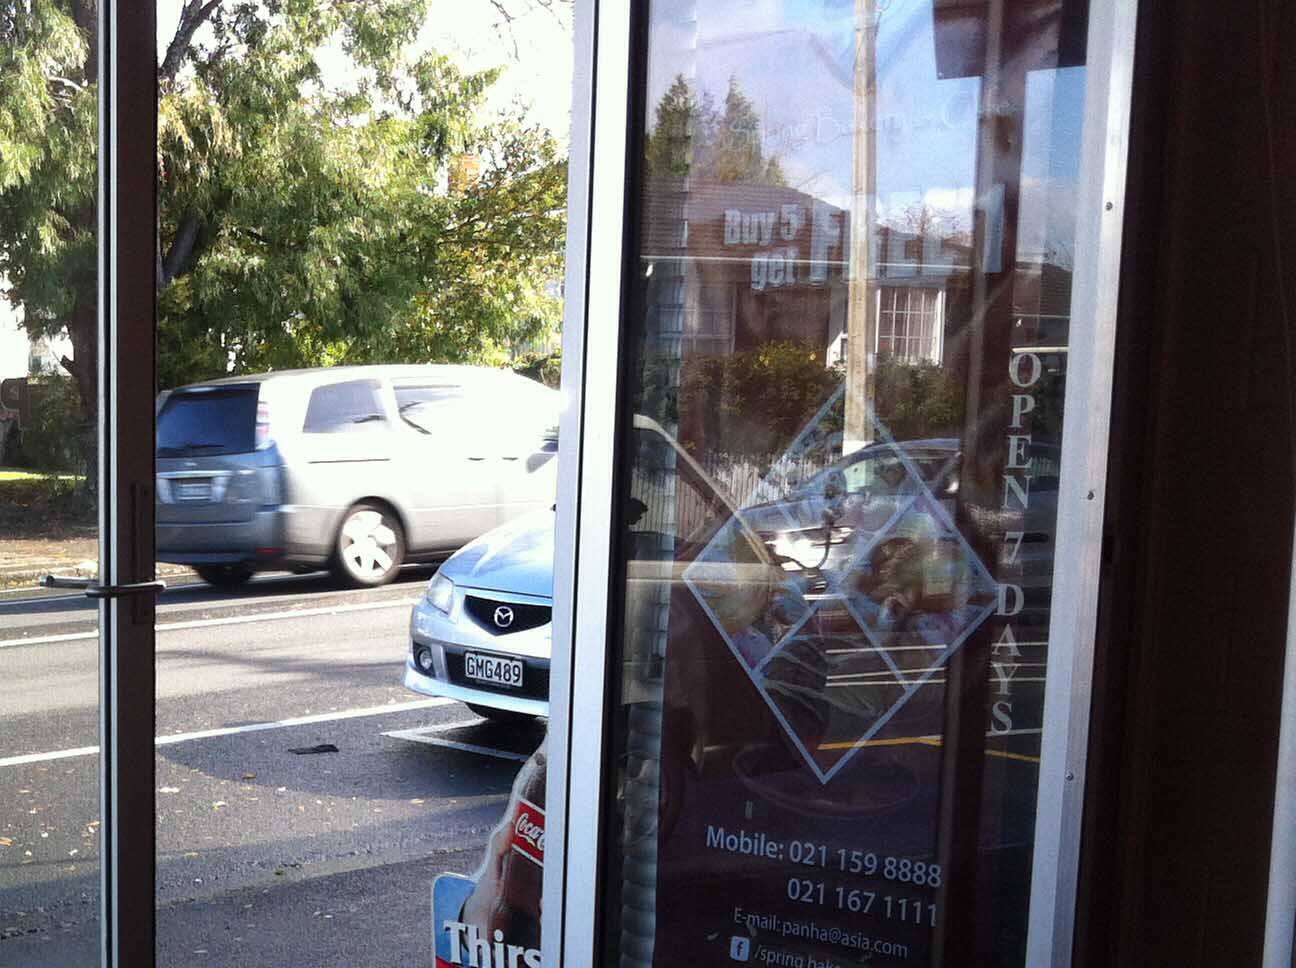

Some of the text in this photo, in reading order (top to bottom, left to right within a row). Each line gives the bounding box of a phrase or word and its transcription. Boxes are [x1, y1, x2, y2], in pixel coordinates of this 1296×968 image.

[723, 203, 800, 246] Buy 5
[751, 246, 799, 291] get
[990, 352, 1042, 736] OPEN 7 DAYS
[466, 656, 521, 684] GMG489
[705, 825, 942, 888] Mobile: 021 159 8888
[787, 877, 937, 928] 021 167 1111
[734, 907, 909, 958] E-mail: panha@asia.com
